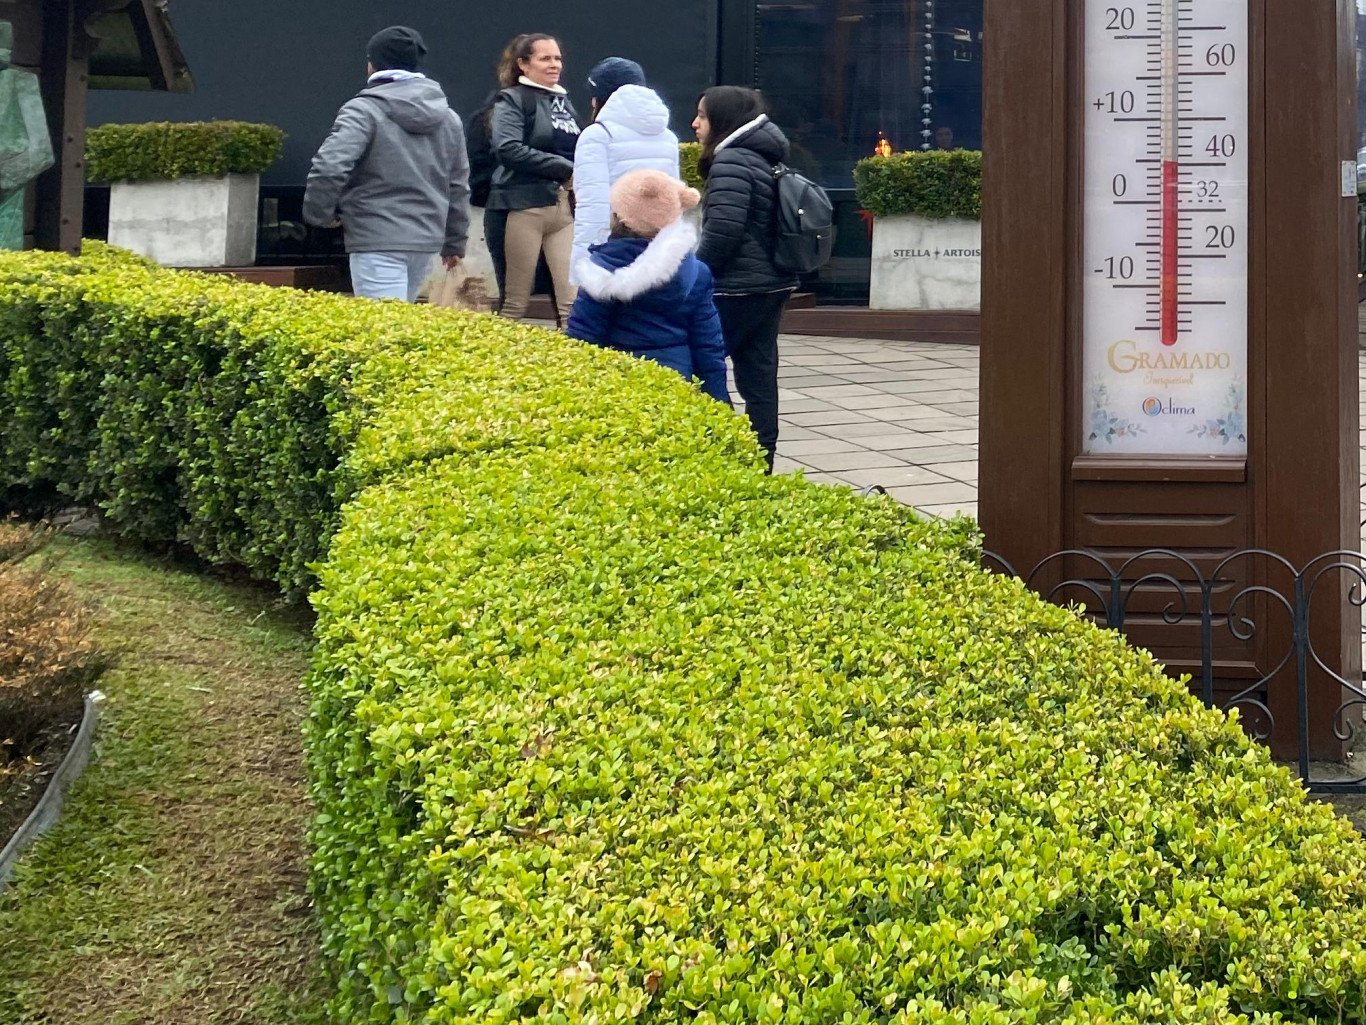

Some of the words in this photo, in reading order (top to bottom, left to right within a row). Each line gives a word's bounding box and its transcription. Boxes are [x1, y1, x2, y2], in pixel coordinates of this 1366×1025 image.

[1105, 8, 1134, 30] 20
[1206, 43, 1235, 66] 60
[1092, 90, 1134, 113] +10
[1205, 134, 1235, 157] 40
[1112, 174, 1126, 196] 0
[1197, 181, 1219, 197] 32
[1205, 225, 1235, 248] 20
[893, 249, 931, 257] STELLA
[943, 249, 980, 257] ARTOIS
[1094, 256, 1133, 279] -10
[1108, 340, 1230, 373] GRAMADO
